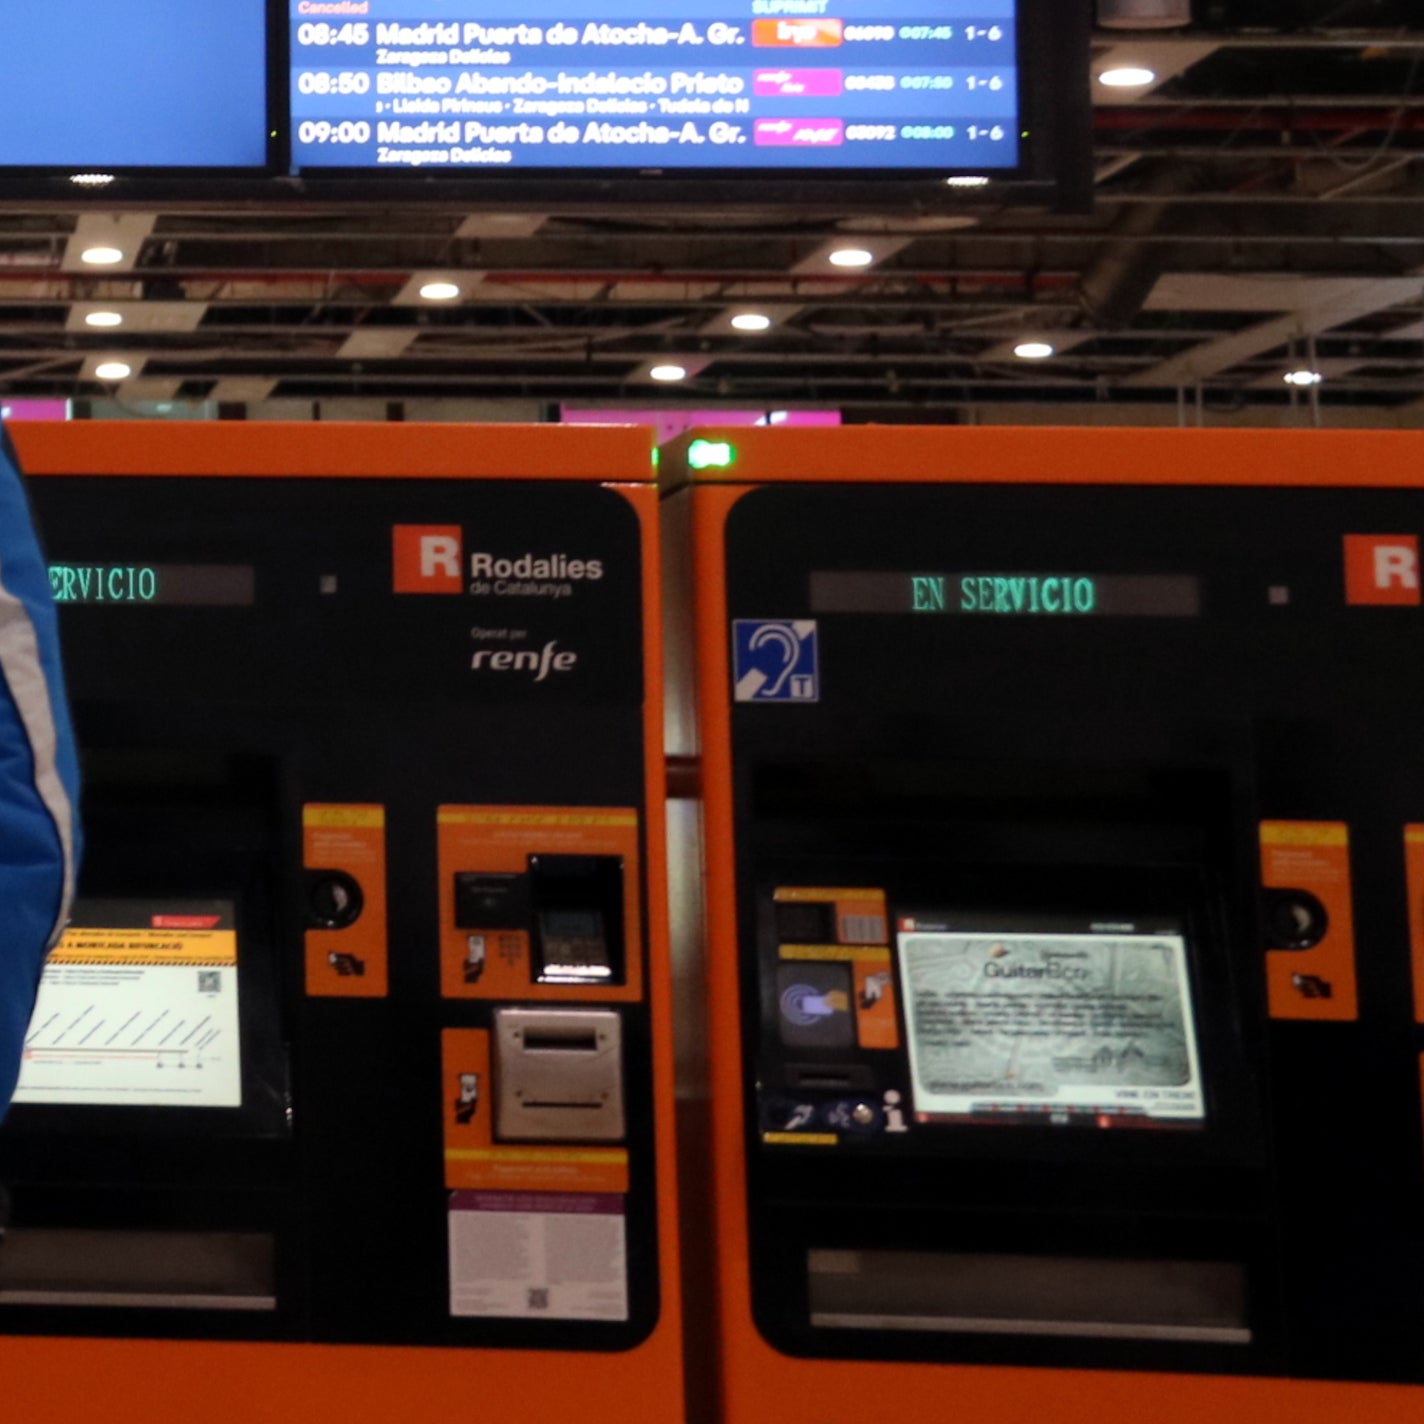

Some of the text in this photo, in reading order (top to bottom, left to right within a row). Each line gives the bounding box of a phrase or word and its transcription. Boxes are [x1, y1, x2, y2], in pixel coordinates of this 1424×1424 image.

[420, 535, 460, 577] R
[471, 553, 603, 579] Rodalies
[1373, 545, 1418, 588] R
[494, 581, 571, 598] Catalunya
[912, 576, 1094, 612] EN SERVICIO
[471, 641, 577, 682] renfe
